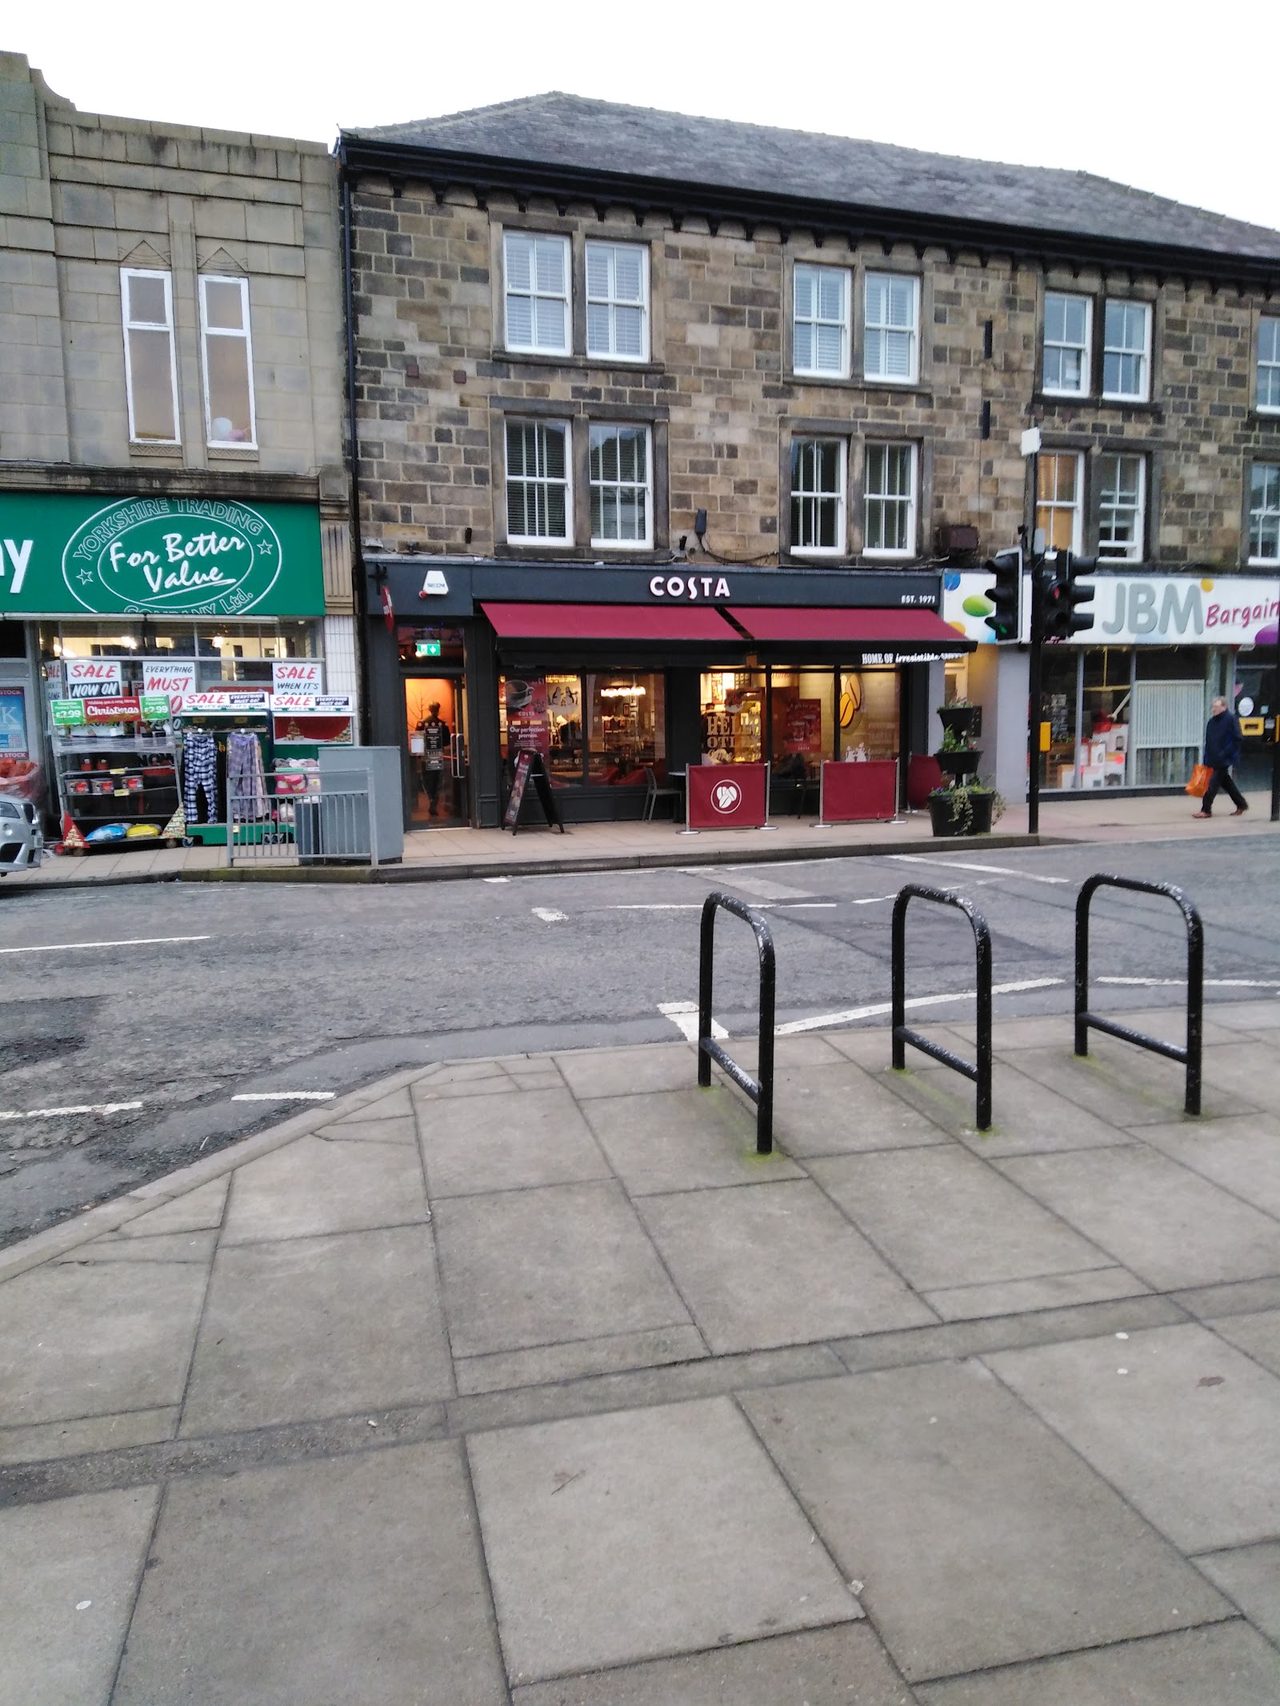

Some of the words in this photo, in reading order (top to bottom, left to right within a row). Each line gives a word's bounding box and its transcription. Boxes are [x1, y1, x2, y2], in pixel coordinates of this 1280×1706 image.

[72, 499, 170, 562] YORKSHIRE
[175, 497, 265, 537] TRADING
[109, 541, 161, 573] For
[162, 531, 247, 564] Better
[142, 563, 225, 594] Value
[649, 575, 732, 600] COSTA
[219, 587, 254, 615] Ltd.
[918, 594, 936, 604] 1971
[1101, 581, 1205, 636] JBM
[70, 664, 117, 678] SALE
[145, 665, 193, 674] EVERYTHING
[275, 666, 317, 680] SALE
[72, 683, 100, 697] NOW
[101, 682, 118, 696] ON
[146, 676, 193, 692] MUST
[277, 682, 301, 690] WHEN
[302, 682, 319, 690] IT'S
[186, 694, 226, 704] SALE
[274, 696, 313, 706] SALE
[87, 704, 140, 717] Christmas
